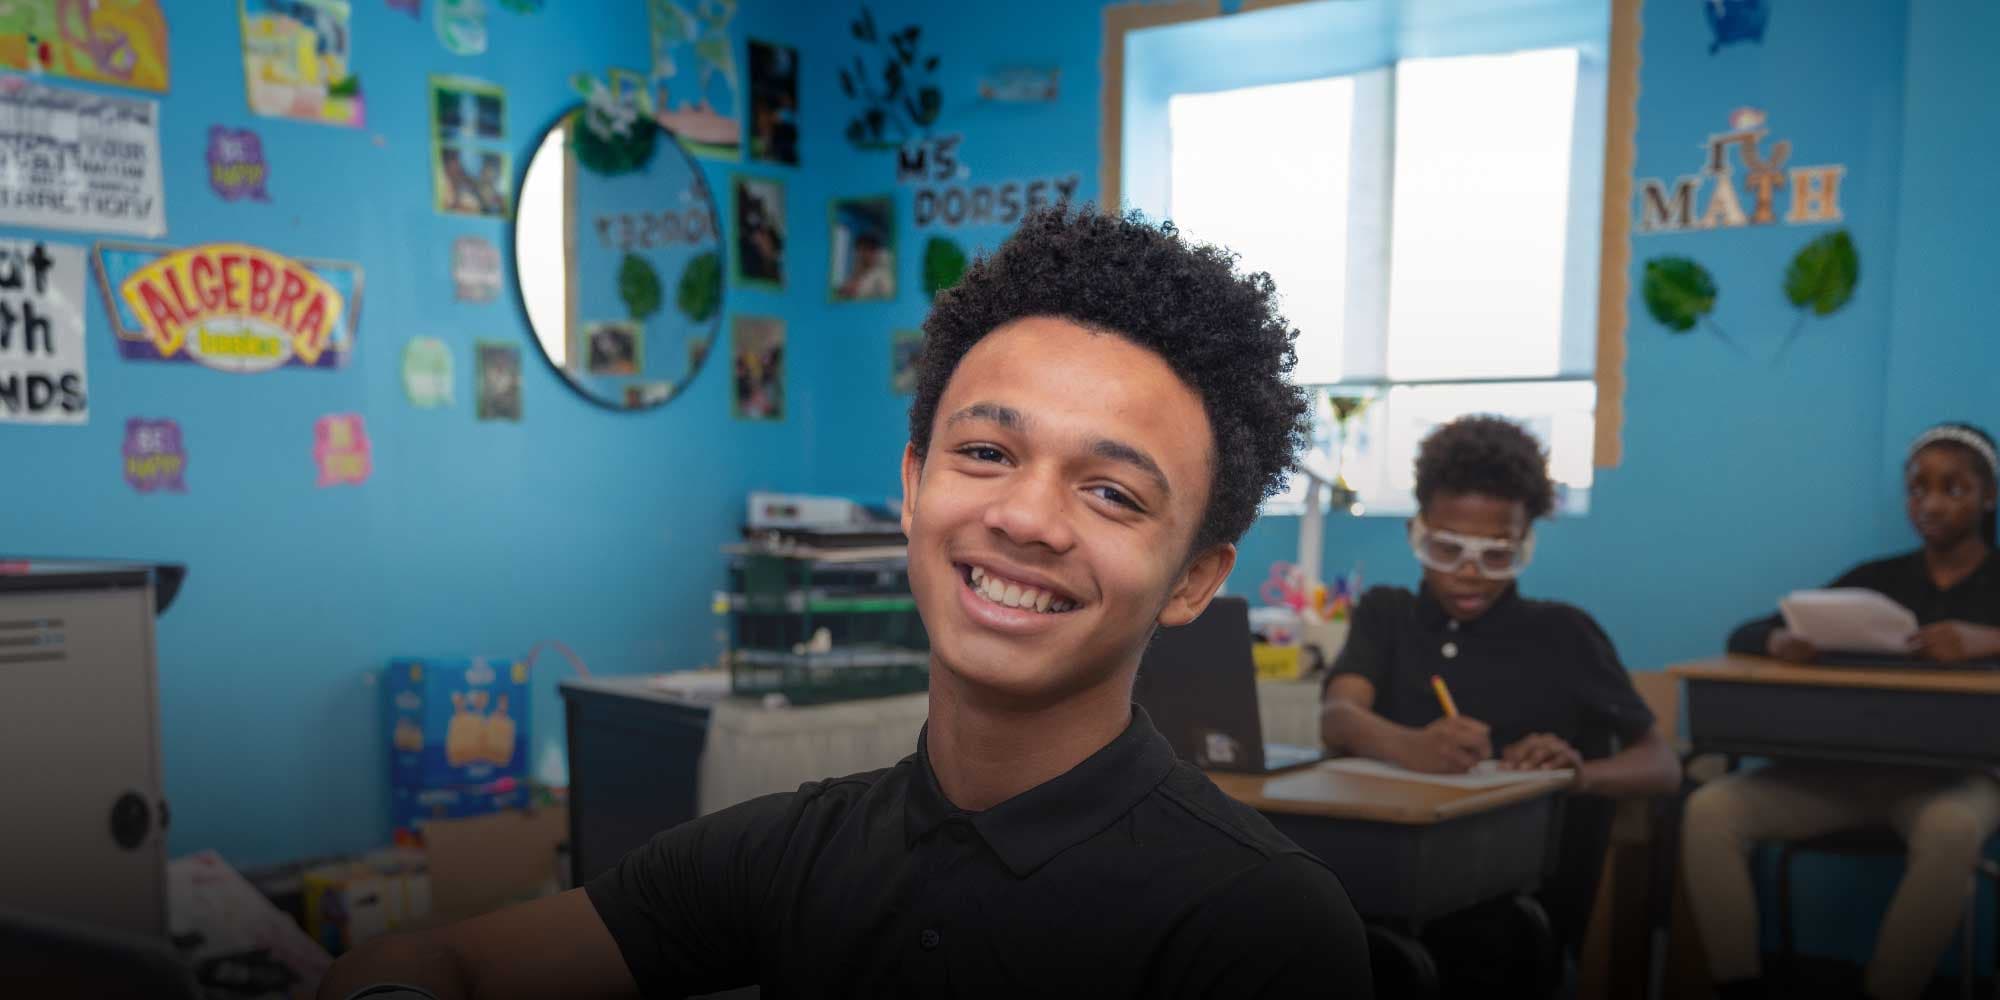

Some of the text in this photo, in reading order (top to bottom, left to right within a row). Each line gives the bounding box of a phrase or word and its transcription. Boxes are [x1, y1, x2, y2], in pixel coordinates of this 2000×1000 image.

[898, 135, 970, 183] MS.
[914, 175, 1080, 227] DORSEY
[1639, 165, 1846, 231] MATH
[138, 254, 328, 350] ALGEBRA
